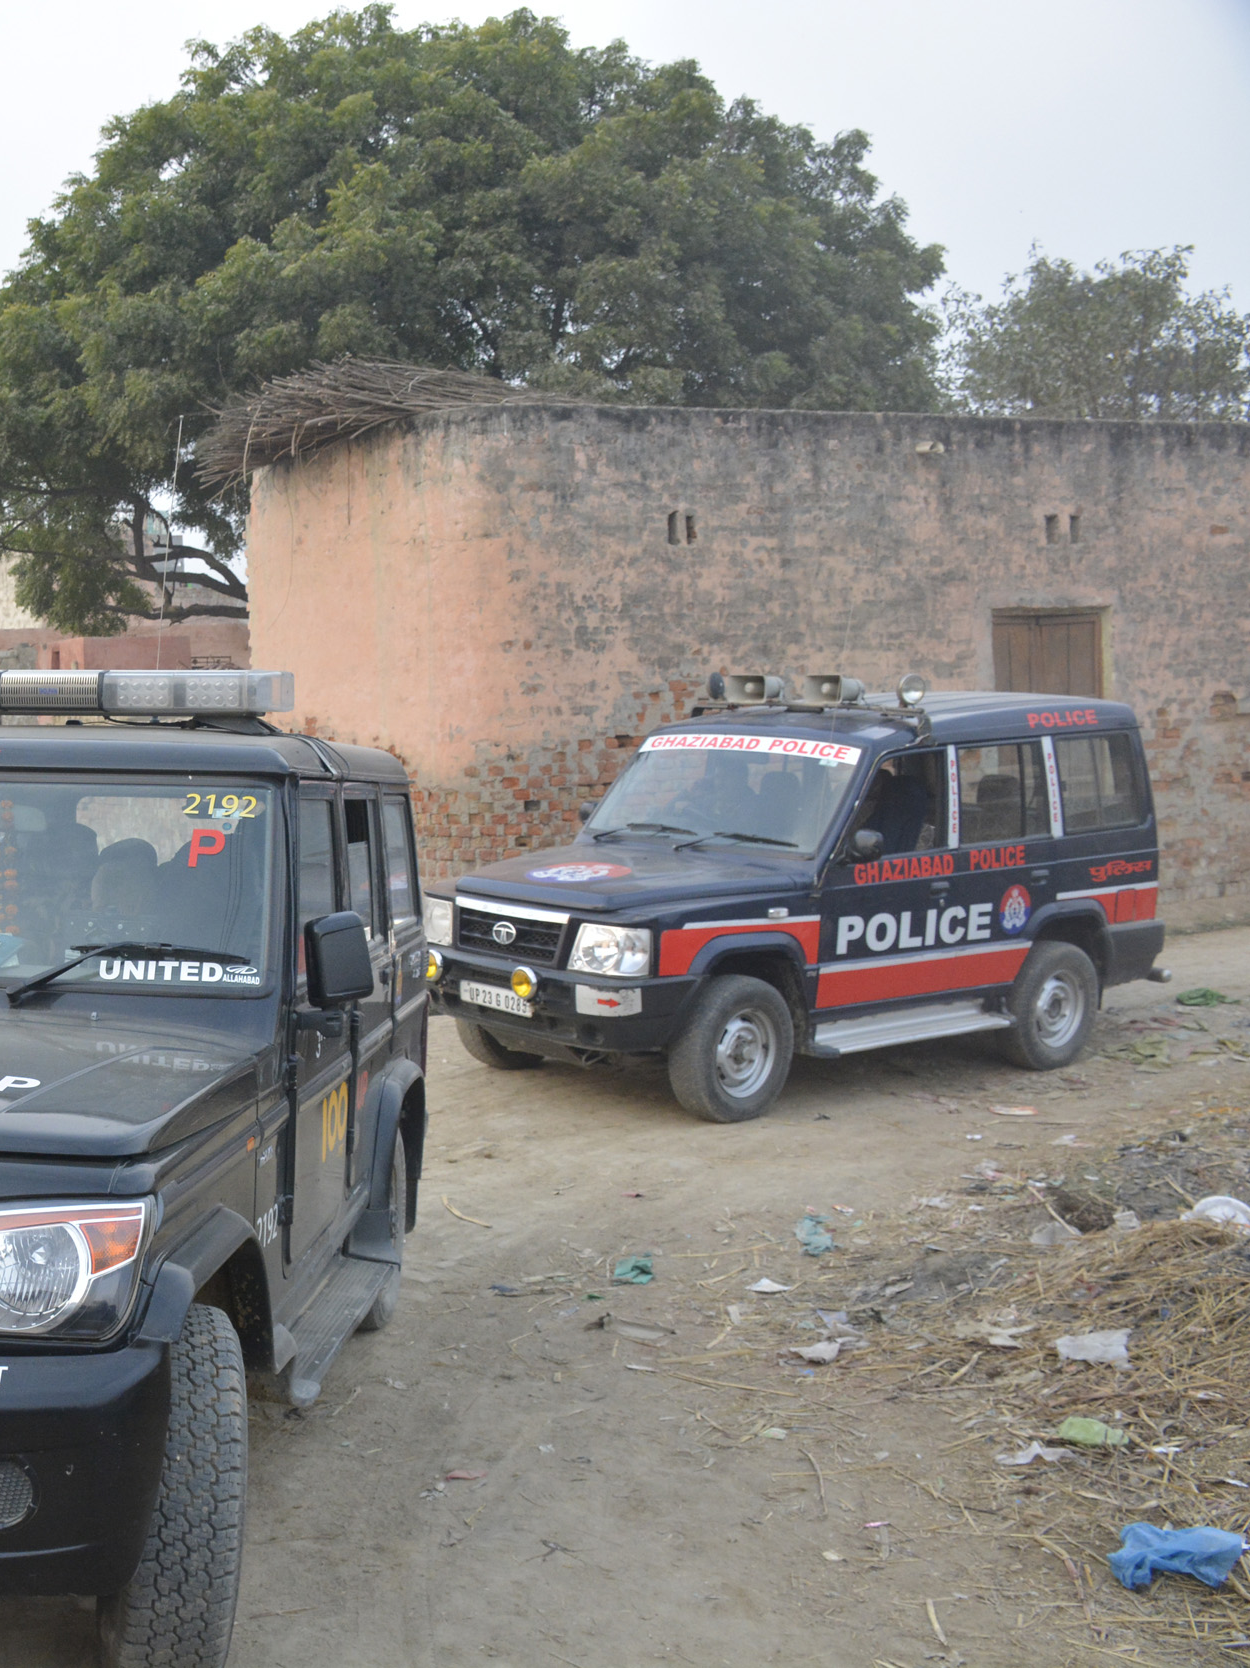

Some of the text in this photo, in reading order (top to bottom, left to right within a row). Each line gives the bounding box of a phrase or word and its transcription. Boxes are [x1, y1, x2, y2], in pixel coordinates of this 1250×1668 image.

[1026, 709, 1099, 729] POLICE
[651, 736, 851, 760] GHAZIABAD POLICE
[950, 760, 958, 834] POLICE
[1047, 753, 1058, 823] POLICE
[182, 793, 257, 818] 2192
[187, 828, 226, 868] P
[854, 845, 1026, 885] GHAZIABAD POLICE
[1089, 859, 1152, 882] पुलिस
[836, 902, 994, 956] POLICE
[100, 960, 223, 982] UNITED
[222, 973, 261, 985] ALLAHABAD
[470, 987, 480, 1002] UP
[482, 989, 493, 1005] 23
[495, 993, 501, 1007] G
[322, 1081, 348, 1163] 100
